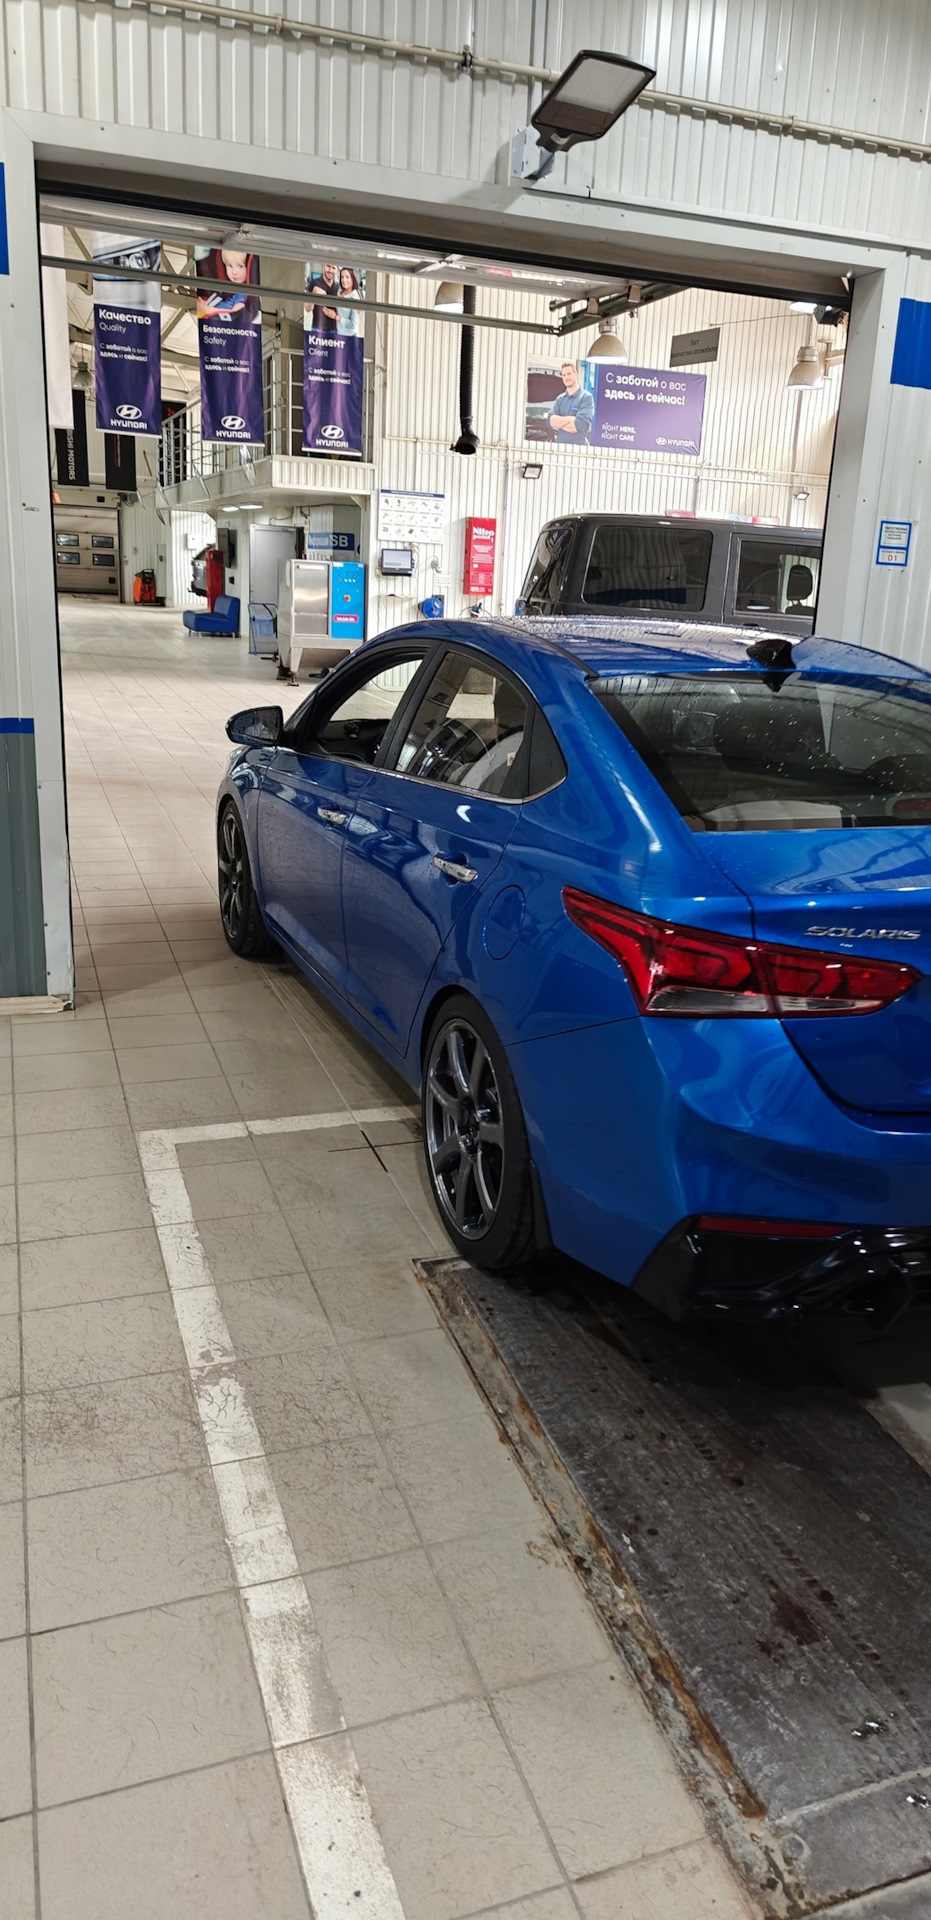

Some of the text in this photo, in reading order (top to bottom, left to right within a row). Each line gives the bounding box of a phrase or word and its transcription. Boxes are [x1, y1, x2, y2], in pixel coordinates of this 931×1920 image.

[99, 308, 151, 325] Качество
[99, 322, 126, 334] Quality
[202, 324, 258, 337] Безопасность
[203, 335, 227, 346] Safety
[308, 334, 346, 349] Клиент
[105, 343, 132, 352] заботой
[308, 346, 329, 357] Client
[100, 350, 119, 359] здесь
[123, 353, 148, 362] сейчас!
[210, 357, 235, 365] заботой
[313, 368, 337, 376] заботой
[605, 372, 687, 392] С заботой о вас
[604, 389, 685, 406] здесь и сейчас!
[110, 418, 148, 430] HYUNDAI
[601, 422, 620, 432] RIGHT
[216, 430, 251, 440] HYUNDAI
[601, 431, 635, 442] RIGHT CARE
[315, 438, 349, 448] HYUNDAI
[667, 438, 695, 448] HYUNDAI
[67, 449, 76, 480] MOTORS
[472, 525, 495, 537] Nitro
[887, 554, 898, 562] 01
[804, 925, 921, 940] SOLARIS
